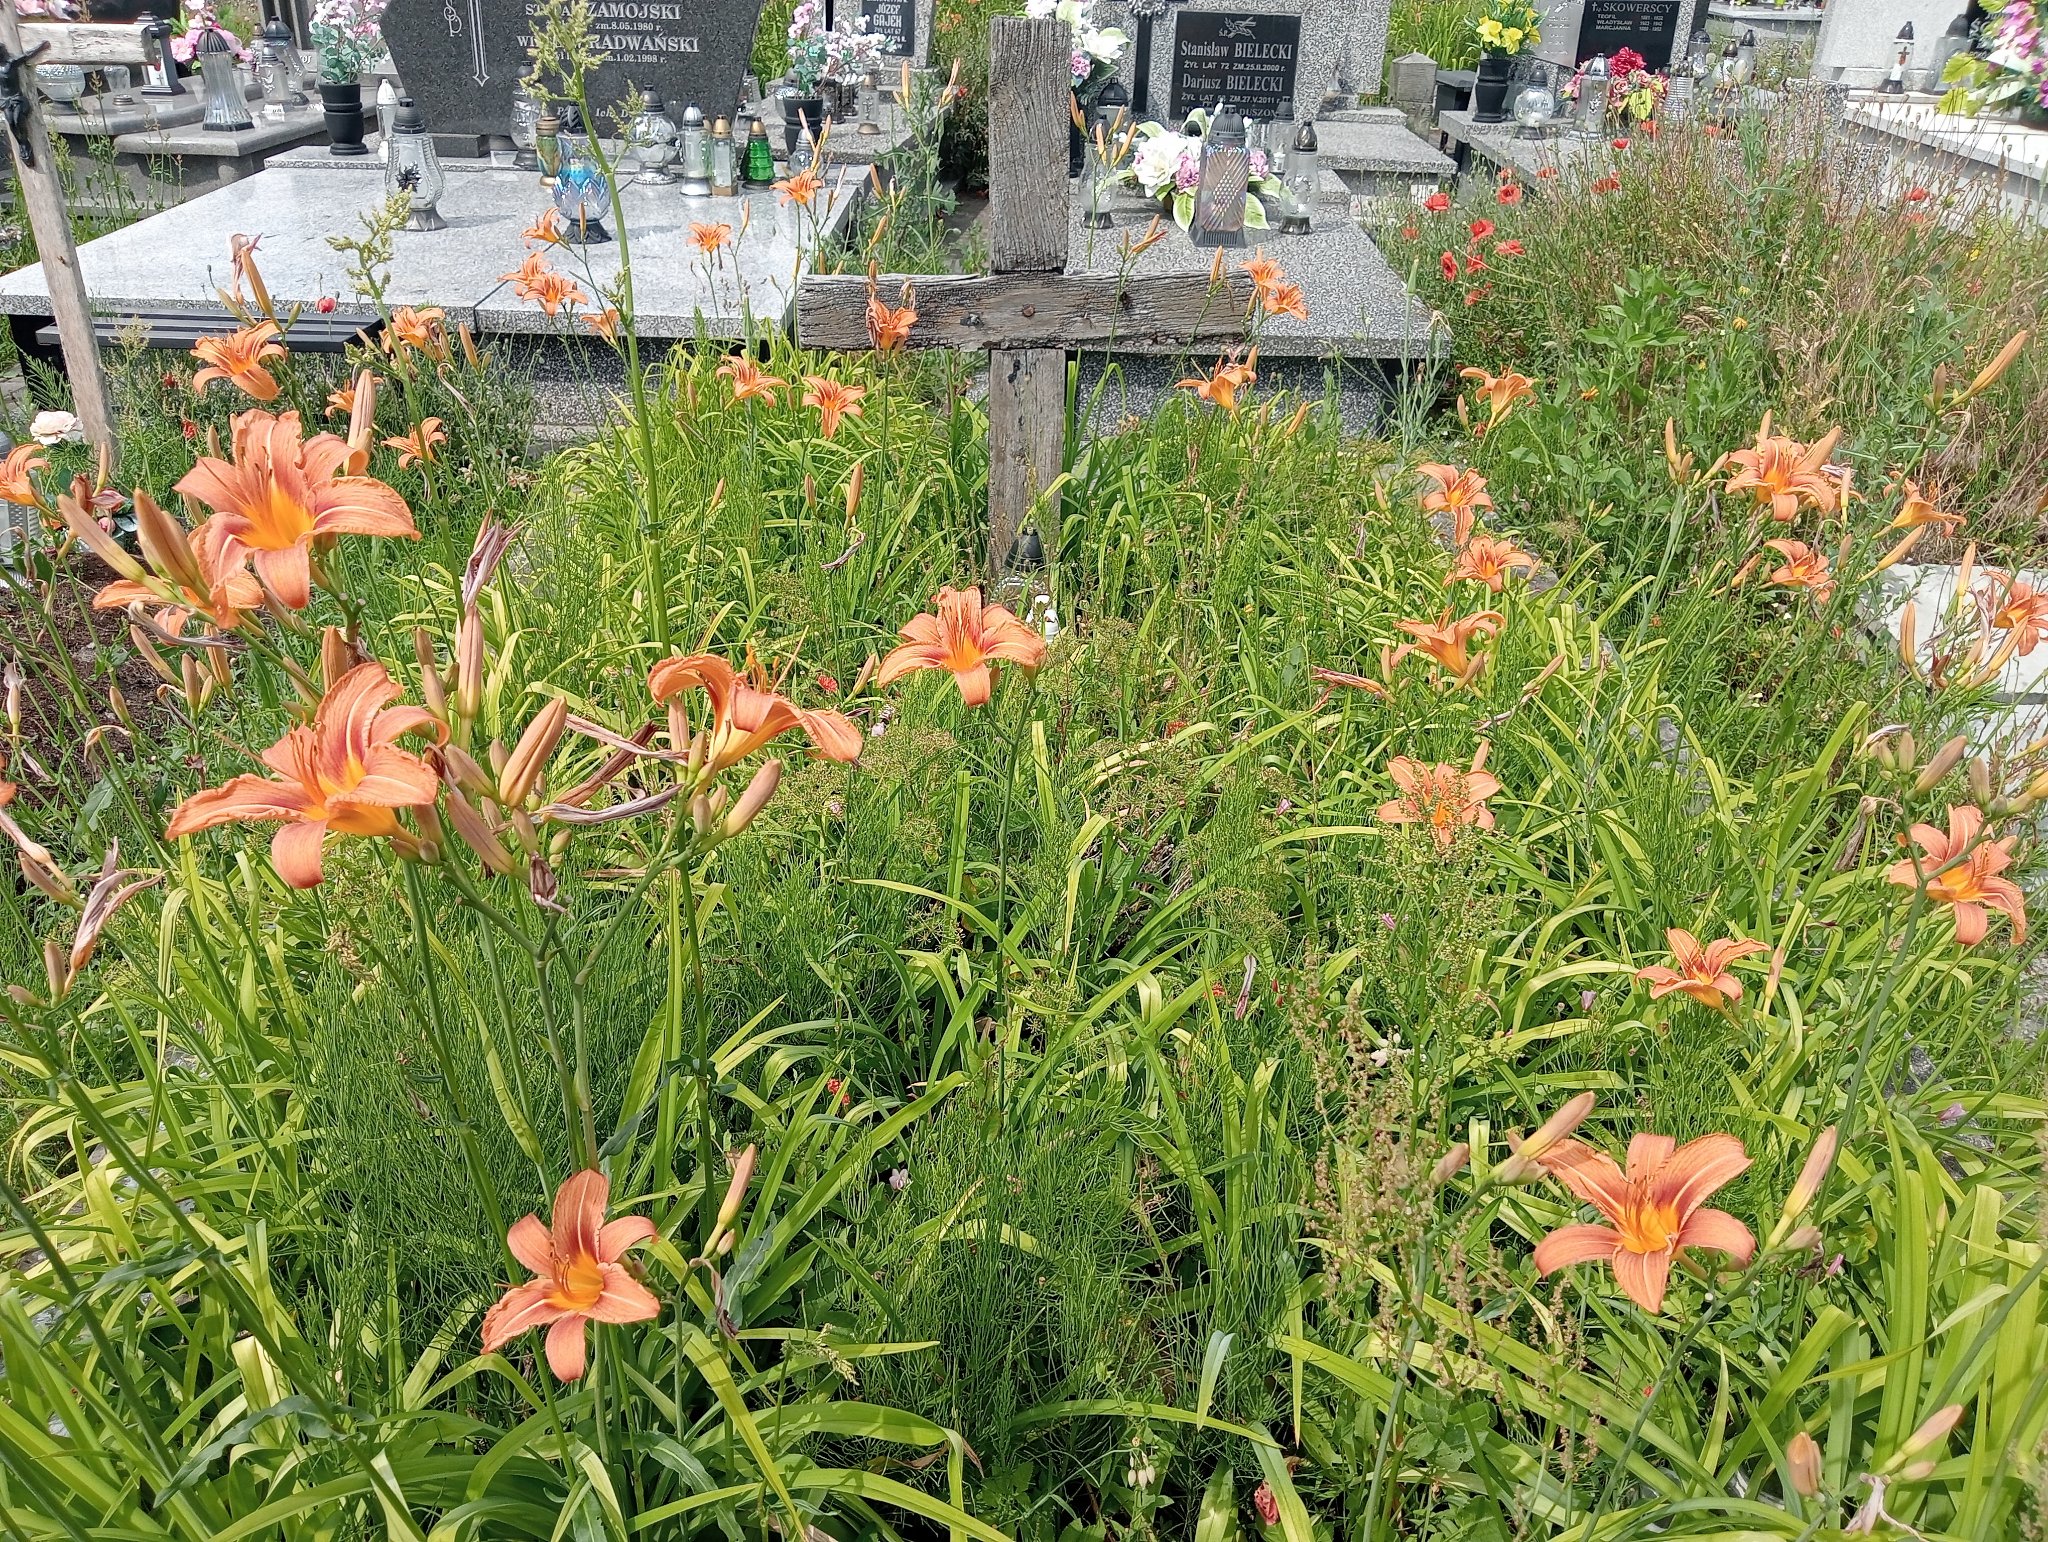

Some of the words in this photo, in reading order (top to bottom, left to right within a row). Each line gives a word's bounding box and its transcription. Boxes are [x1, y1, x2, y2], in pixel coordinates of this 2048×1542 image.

[586, 1, 682, 20] ZAMOJSKI
[875, 3, 901, 15] JÓZEF
[1603, 2, 1673, 13] SKOWERSCY
[595, 21, 653, 31] zm.8.05.1980
[873, 14, 902, 28] GAJEK
[588, 31, 700, 53] RADWAŃSKI
[1180, 40, 1229, 57] Stanisław
[1234, 42, 1293, 60] BIELECKI
[600, 53, 658, 63] m.1.02.1998
[1183, 60, 1199, 69] ŻYŁ
[1202, 61, 1217, 70] LAT
[1220, 62, 1230, 70] 72
[1182, 73, 1222, 90] Dariusz
[1226, 74, 1284, 92] BIELECKI
[1181, 92, 1196, 101] ŻYŁ
[1199, 94, 1214, 102] LAT
